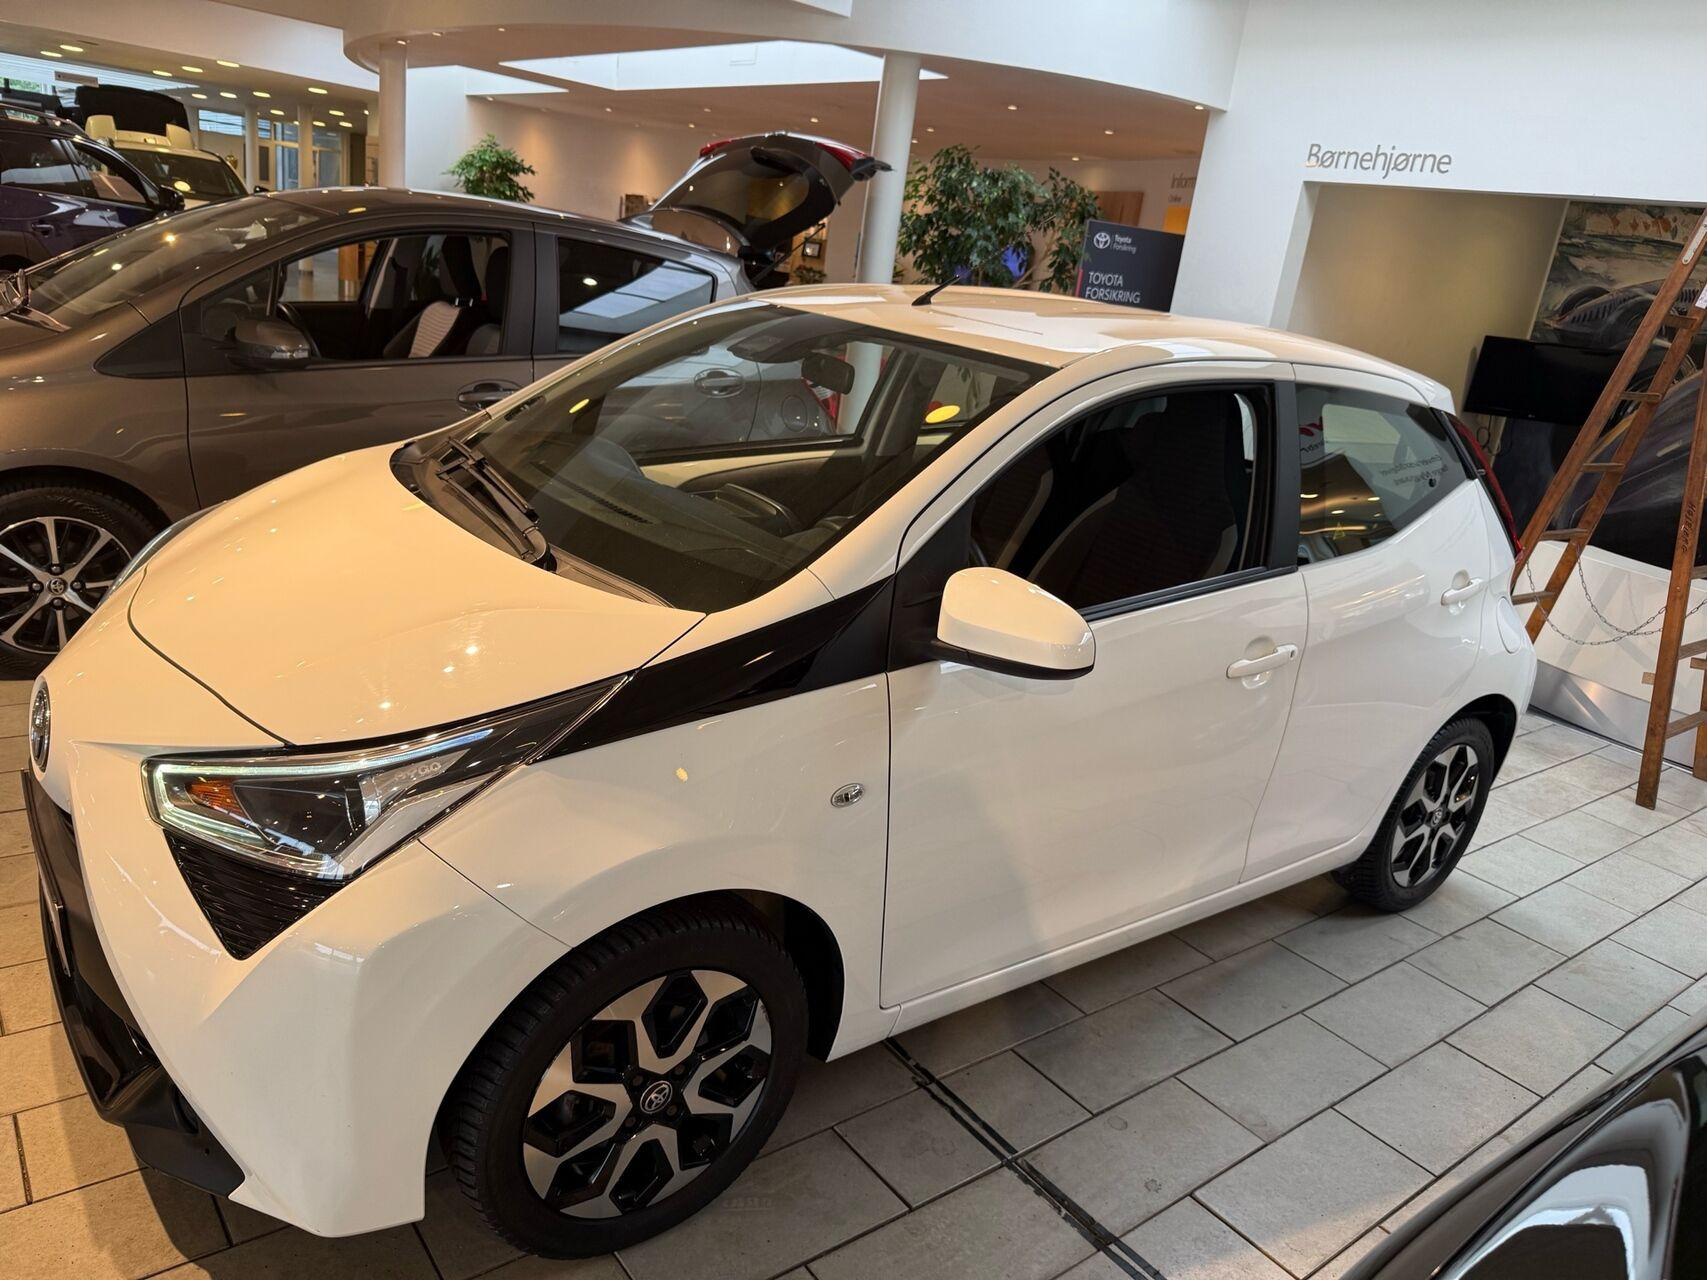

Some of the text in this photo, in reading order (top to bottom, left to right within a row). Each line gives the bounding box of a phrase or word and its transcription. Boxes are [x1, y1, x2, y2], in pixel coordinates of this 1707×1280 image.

[1305, 143, 1452, 179] Børnehjørne
[1114, 234, 1132, 244] Toyota
[1113, 242, 1137, 255] Forsikring
[1088, 271, 1124, 287] TOYOTA
[1085, 287, 1141, 304] FORSIKRING
